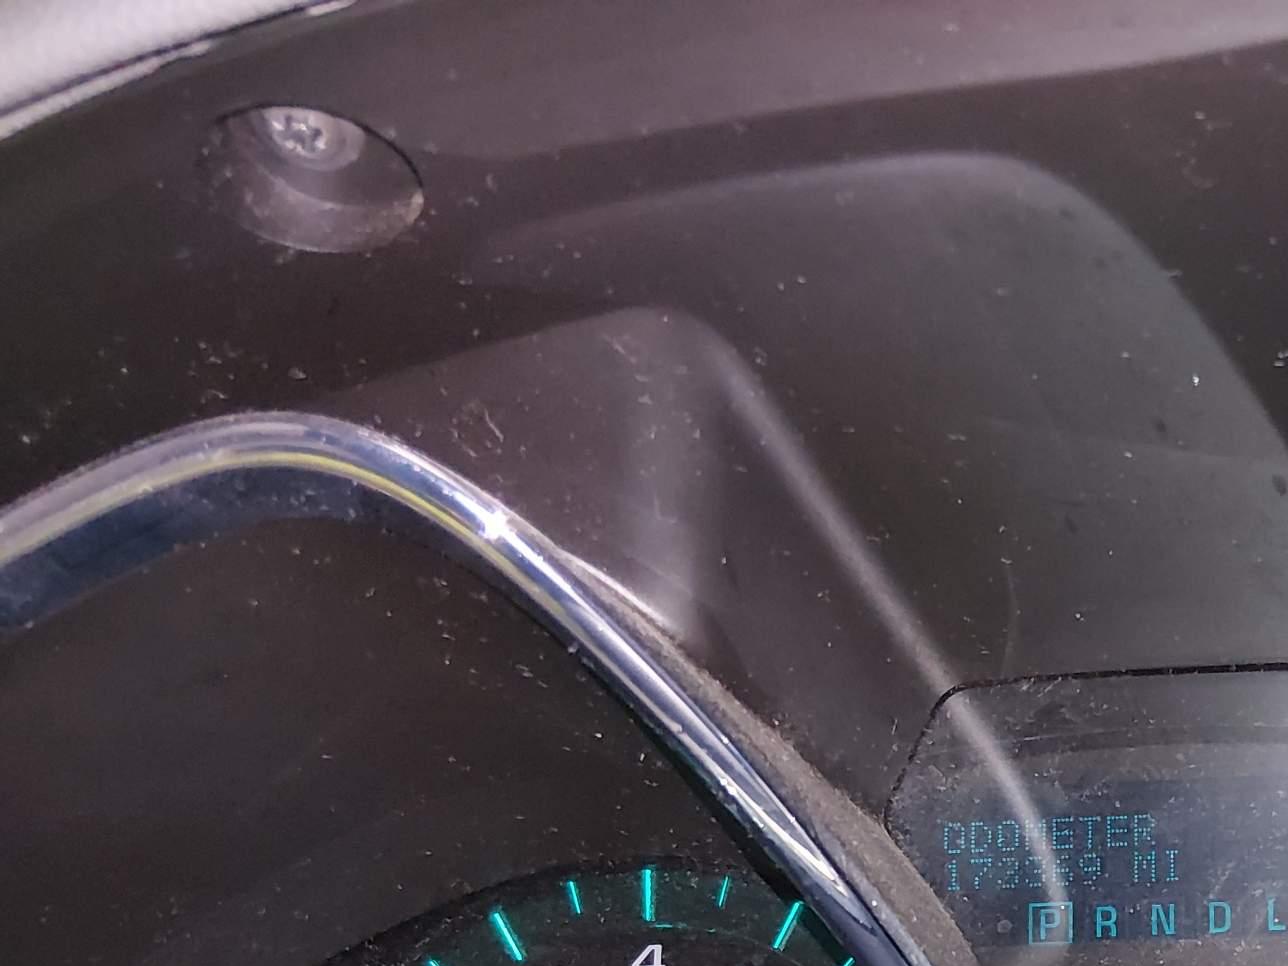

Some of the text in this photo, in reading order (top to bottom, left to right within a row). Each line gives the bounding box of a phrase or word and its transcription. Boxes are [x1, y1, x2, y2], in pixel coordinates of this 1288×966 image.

[944, 812, 1156, 855] ODOMETER
[1133, 848, 1179, 883] MI
[1040, 898, 1286, 940] P R N D L
